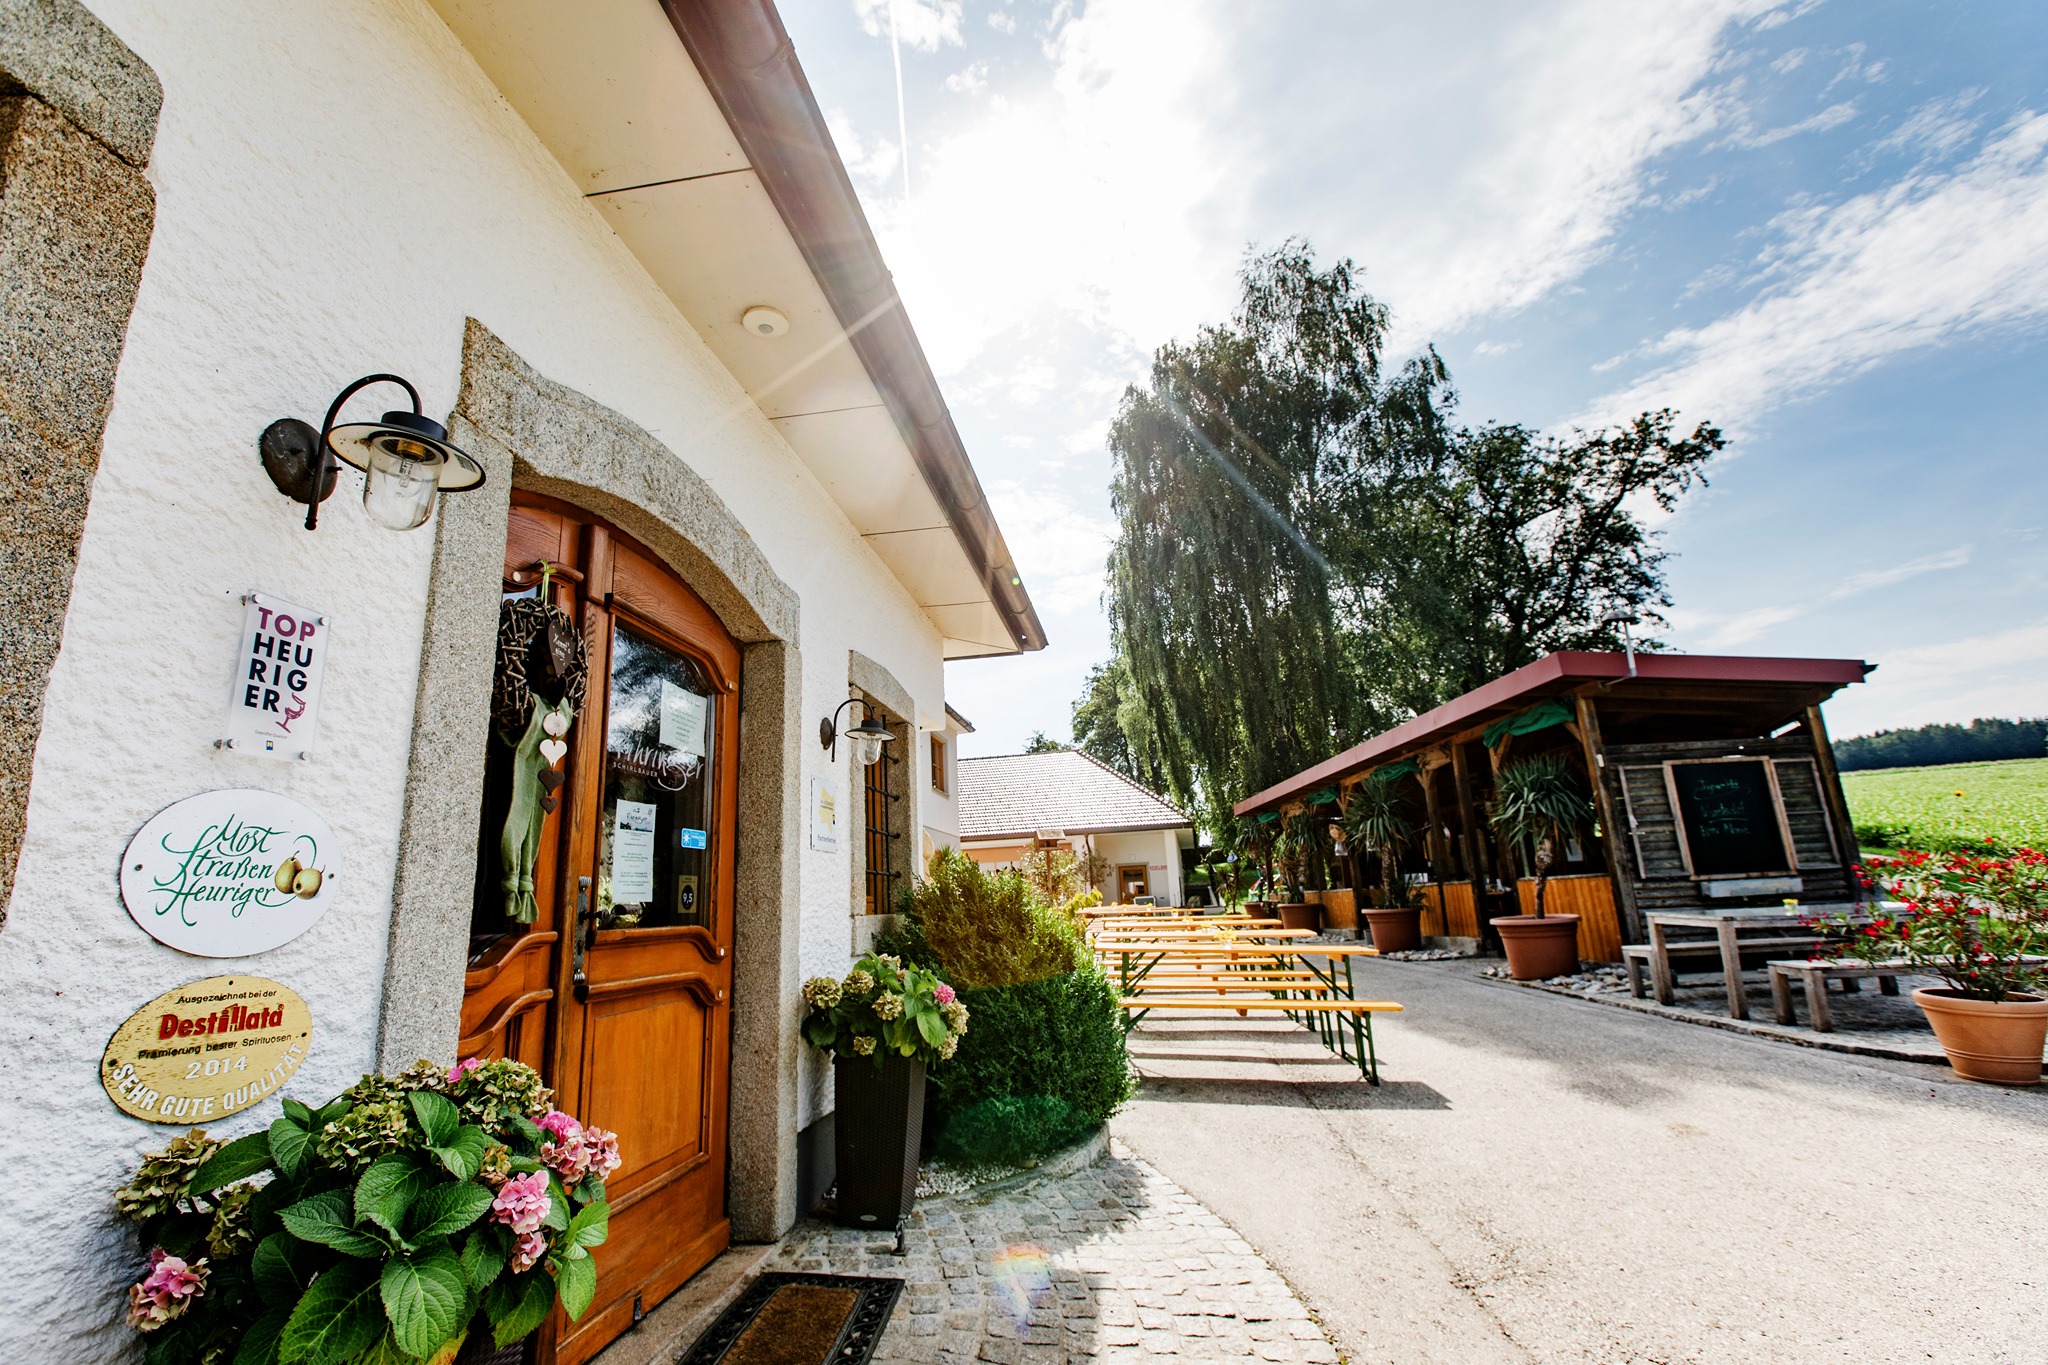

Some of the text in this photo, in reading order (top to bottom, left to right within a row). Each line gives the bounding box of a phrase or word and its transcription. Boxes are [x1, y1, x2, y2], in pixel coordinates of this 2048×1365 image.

[258, 607, 316, 641] TOP
[252, 632, 313, 667] HEU
[248, 658, 308, 692] RIG
[244, 684, 280, 713] ER
[187, 814, 290, 857] Most
[154, 836, 275, 886] Straßen
[150, 869, 277, 922] Heuriger
[175, 990, 277, 1004] Ausgezeichnet bei der
[159, 1003, 283, 1040] Destillata
[138, 1033, 291, 1060] Prämierung bester Spirituosen
[112, 1043, 303, 1117] SEHR GUTE QUALITÄT
[185, 1055, 247, 1080] 2014
